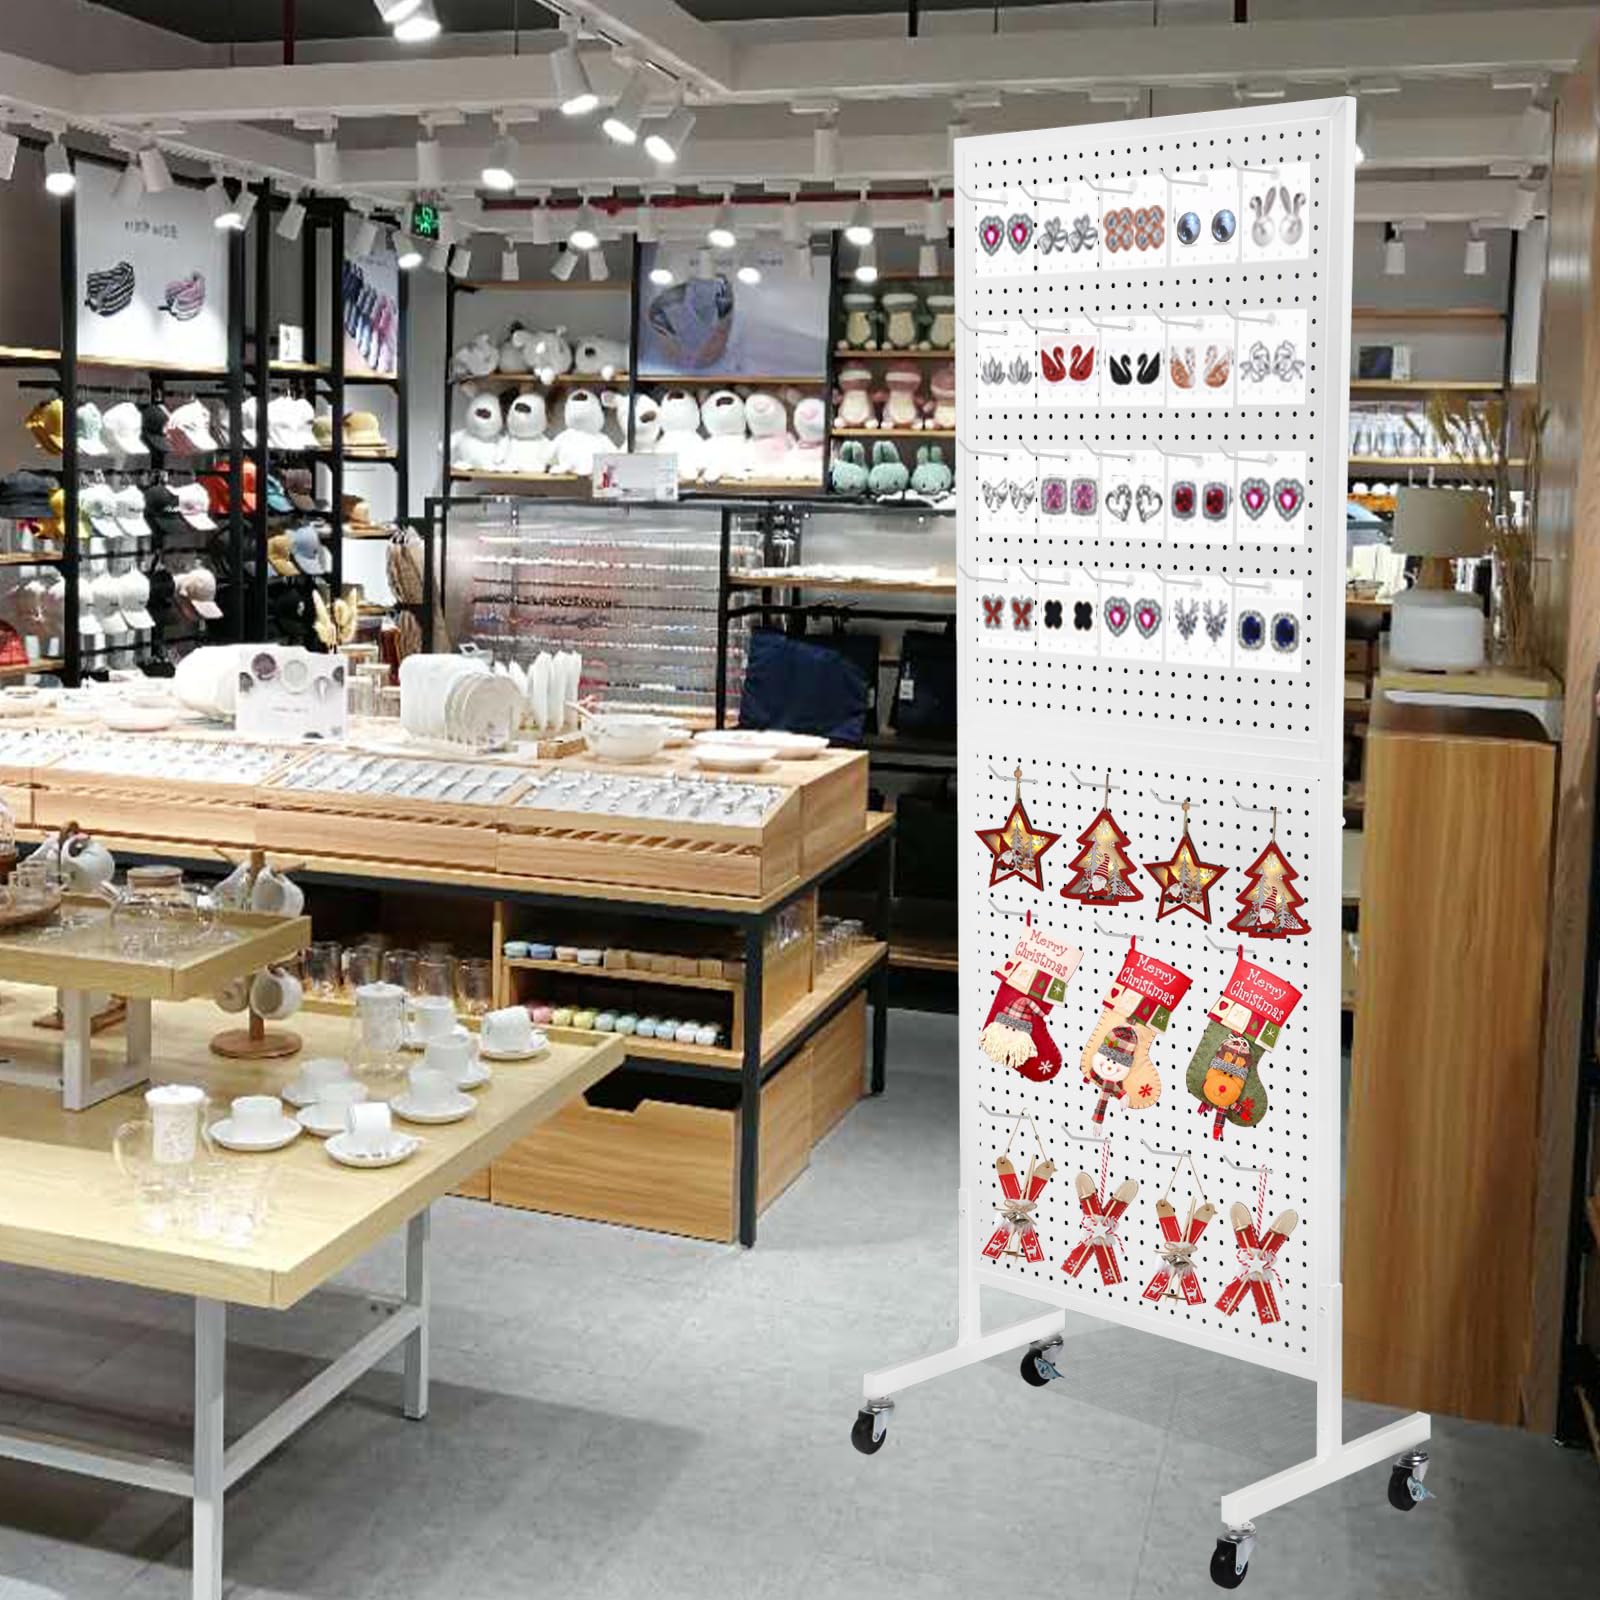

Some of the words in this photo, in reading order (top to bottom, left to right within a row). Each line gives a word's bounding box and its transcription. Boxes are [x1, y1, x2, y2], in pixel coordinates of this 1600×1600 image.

[1015, 941, 1068, 977] Christmas
[1030, 929, 1068, 957] Merry
[1120, 967, 1175, 1006] Christmas
[1136, 954, 1176, 985] Merry
[1247, 968, 1286, 1000] Merry
[1230, 980, 1285, 1022] Christmas
